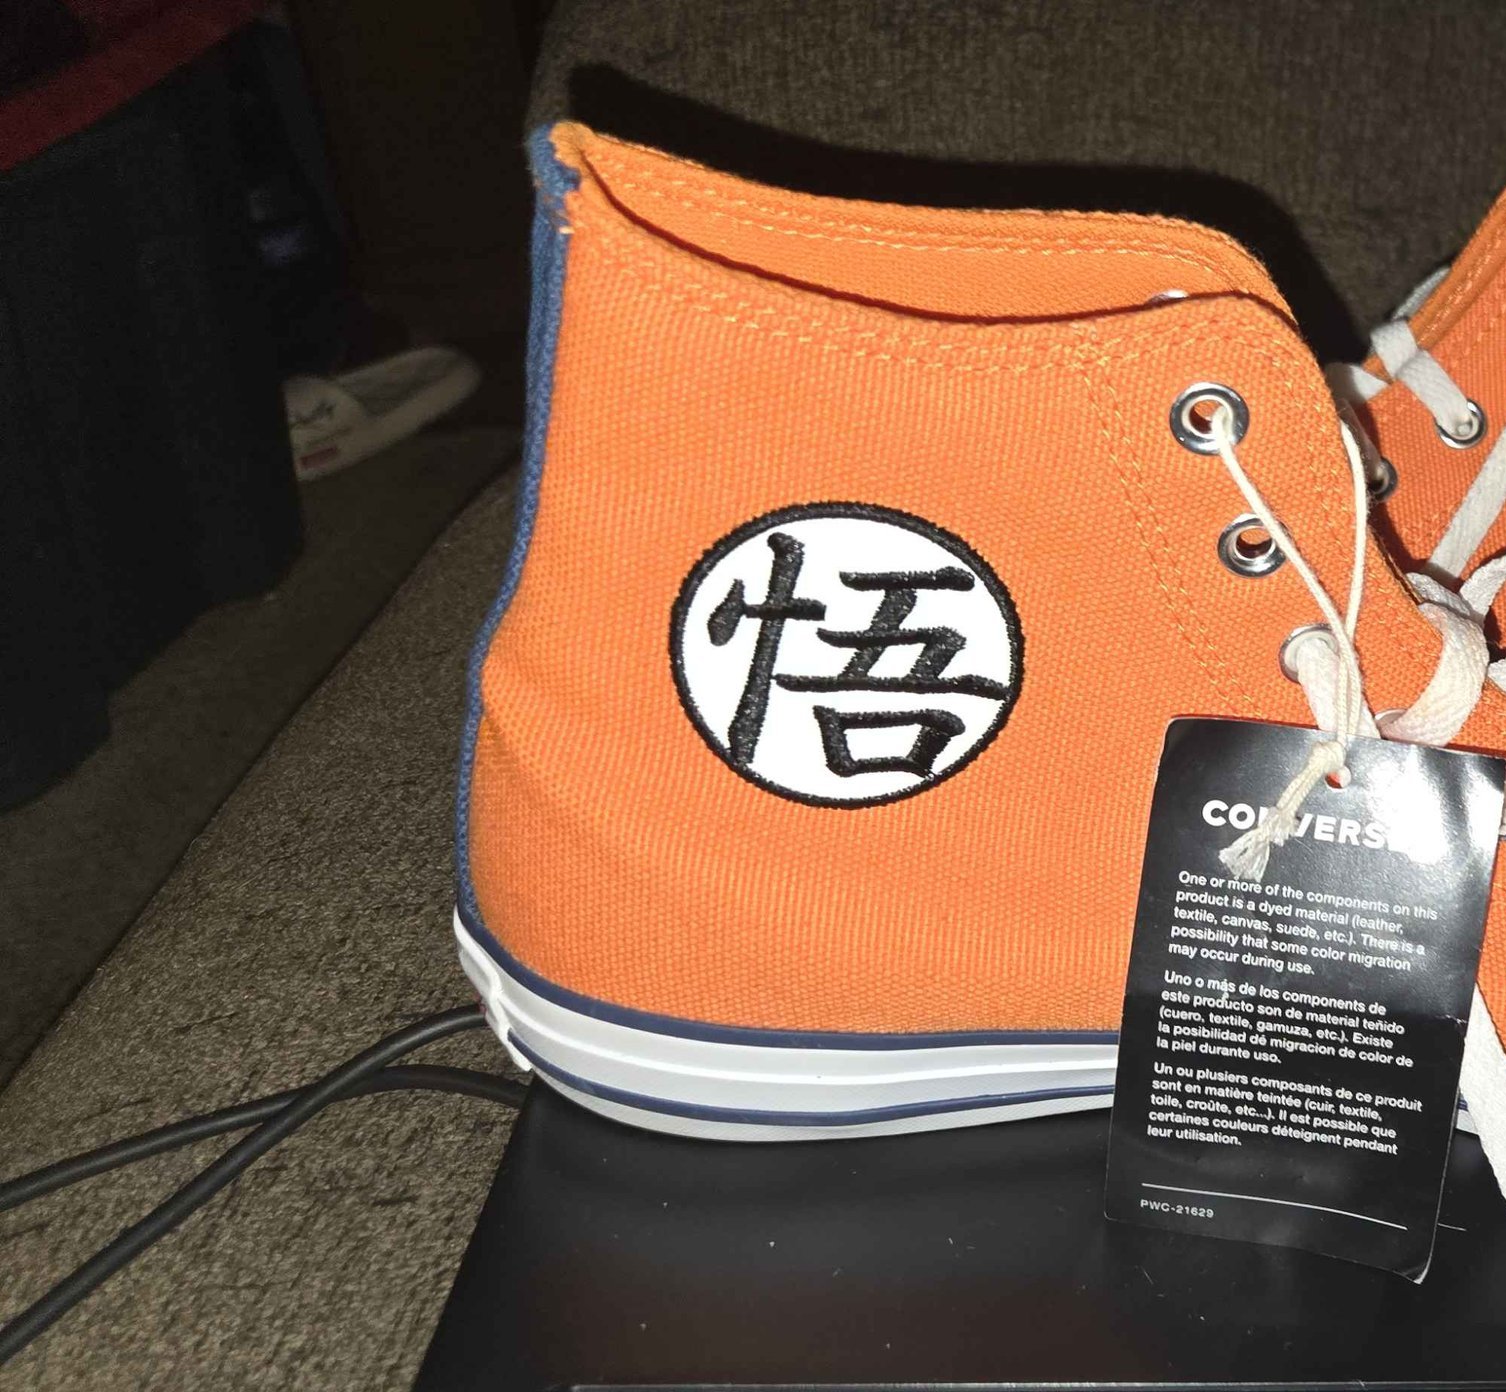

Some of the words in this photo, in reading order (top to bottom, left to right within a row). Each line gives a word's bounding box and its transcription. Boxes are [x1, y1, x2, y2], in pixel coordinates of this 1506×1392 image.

[707, 531, 1012, 778] 悟
[1202, 798, 1405, 853] COVERS
[1176, 891, 1229, 907] product
[1247, 901, 1255, 910] a
[1259, 900, 1292, 916] dyed
[1295, 908, 1348, 924] material
[1179, 871, 1207, 886] One
[1210, 878, 1226, 888] or
[1228, 878, 1262, 893] more
[1265, 884, 1280, 896] of
[1282, 886, 1304, 900] the
[1307, 892, 1389, 912] components
[1394, 905, 1409, 915] on
[1414, 907, 1437, 920] this
[1171, 926, 1238, 947] possibility
[1242, 934, 1268, 949] that
[1271, 941, 1308, 955] some
[1311, 947, 1346, 960] color
[1348, 952, 1413, 971] migration
[1174, 906, 1217, 924] textile,
[1222, 915, 1272, 932] canvas,
[1416, 945, 1426, 956] a
[1168, 944, 1198, 959] may
[1200, 948, 1239, 962] occur
[1242, 952, 1284, 972] during
[1288, 962, 1314, 975] use.
[1162, 990, 1190, 1003] este
[1193, 995, 1254, 1013] producto
[1258, 1005, 1281, 1017] son
[1285, 1007, 1302, 1020] de
[1306, 1012, 1359, 1028] material
[1363, 1018, 1405, 1034] teñido
[1164, 970, 1192, 986] Uno
[1195, 978, 1204, 988] o
[1207, 978, 1236, 993] más
[1239, 982, 1256, 996] de
[1260, 984, 1279, 999] los
[1282, 991, 1366, 1012] components
[1368, 1002, 1386, 1015] de
[1156, 1036, 1168, 1049] la
[1172, 1039, 1196, 1052] piel
[1199, 1042, 1250, 1059] durante
[1254, 1051, 1282, 1064] uso.
[1158, 1021, 1170, 1033] la
[1173, 1026, 1246, 1042] posibilidad
[1270, 1038, 1336, 1056] migracion
[1338, 1046, 1356, 1058] de
[1358, 1051, 1394, 1064] color
[1396, 1055, 1414, 1067] de
[1210, 1012, 1252, 1030] textile,
[1257, 1021, 1312, 1038] gamuza,
[1353, 1032, 1393, 1048] Existe
[1152, 1080, 1182, 1092] sont
[1185, 1084, 1201, 1094] en
[1205, 1086, 1254, 1100] matière
[1257, 1091, 1301, 1107] teintée
[1340, 1104, 1382, 1122] textile,
[1154, 1062, 1173, 1075] Un
[1176, 1067, 1193, 1078] ou
[1196, 1068, 1248, 1084] plusiers
[1251, 1076, 1332, 1096] composants
[1335, 1088, 1353, 1100] de
[1356, 1092, 1372, 1103] ce
[1374, 1095, 1422, 1112] produit
[1147, 1124, 1173, 1138] leur
[1176, 1129, 1242, 1146] utilisation.
[1149, 1111, 1209, 1126] certaines
[1213, 1119, 1269, 1134] couleurs
[1271, 1124, 1341, 1145] déteignent
[1344, 1137, 1398, 1155] pendant
[1150, 1094, 1182, 1108] toile,
[1186, 1100, 1231, 1114] croûte,
[1279, 1109, 1287, 1121] Il
[1290, 1114, 1310, 1124] est
[1313, 1118, 1368, 1133] possible
[1371, 1126, 1396, 1138] que
[1140, 1199, 1214, 1218] PWC-21629
